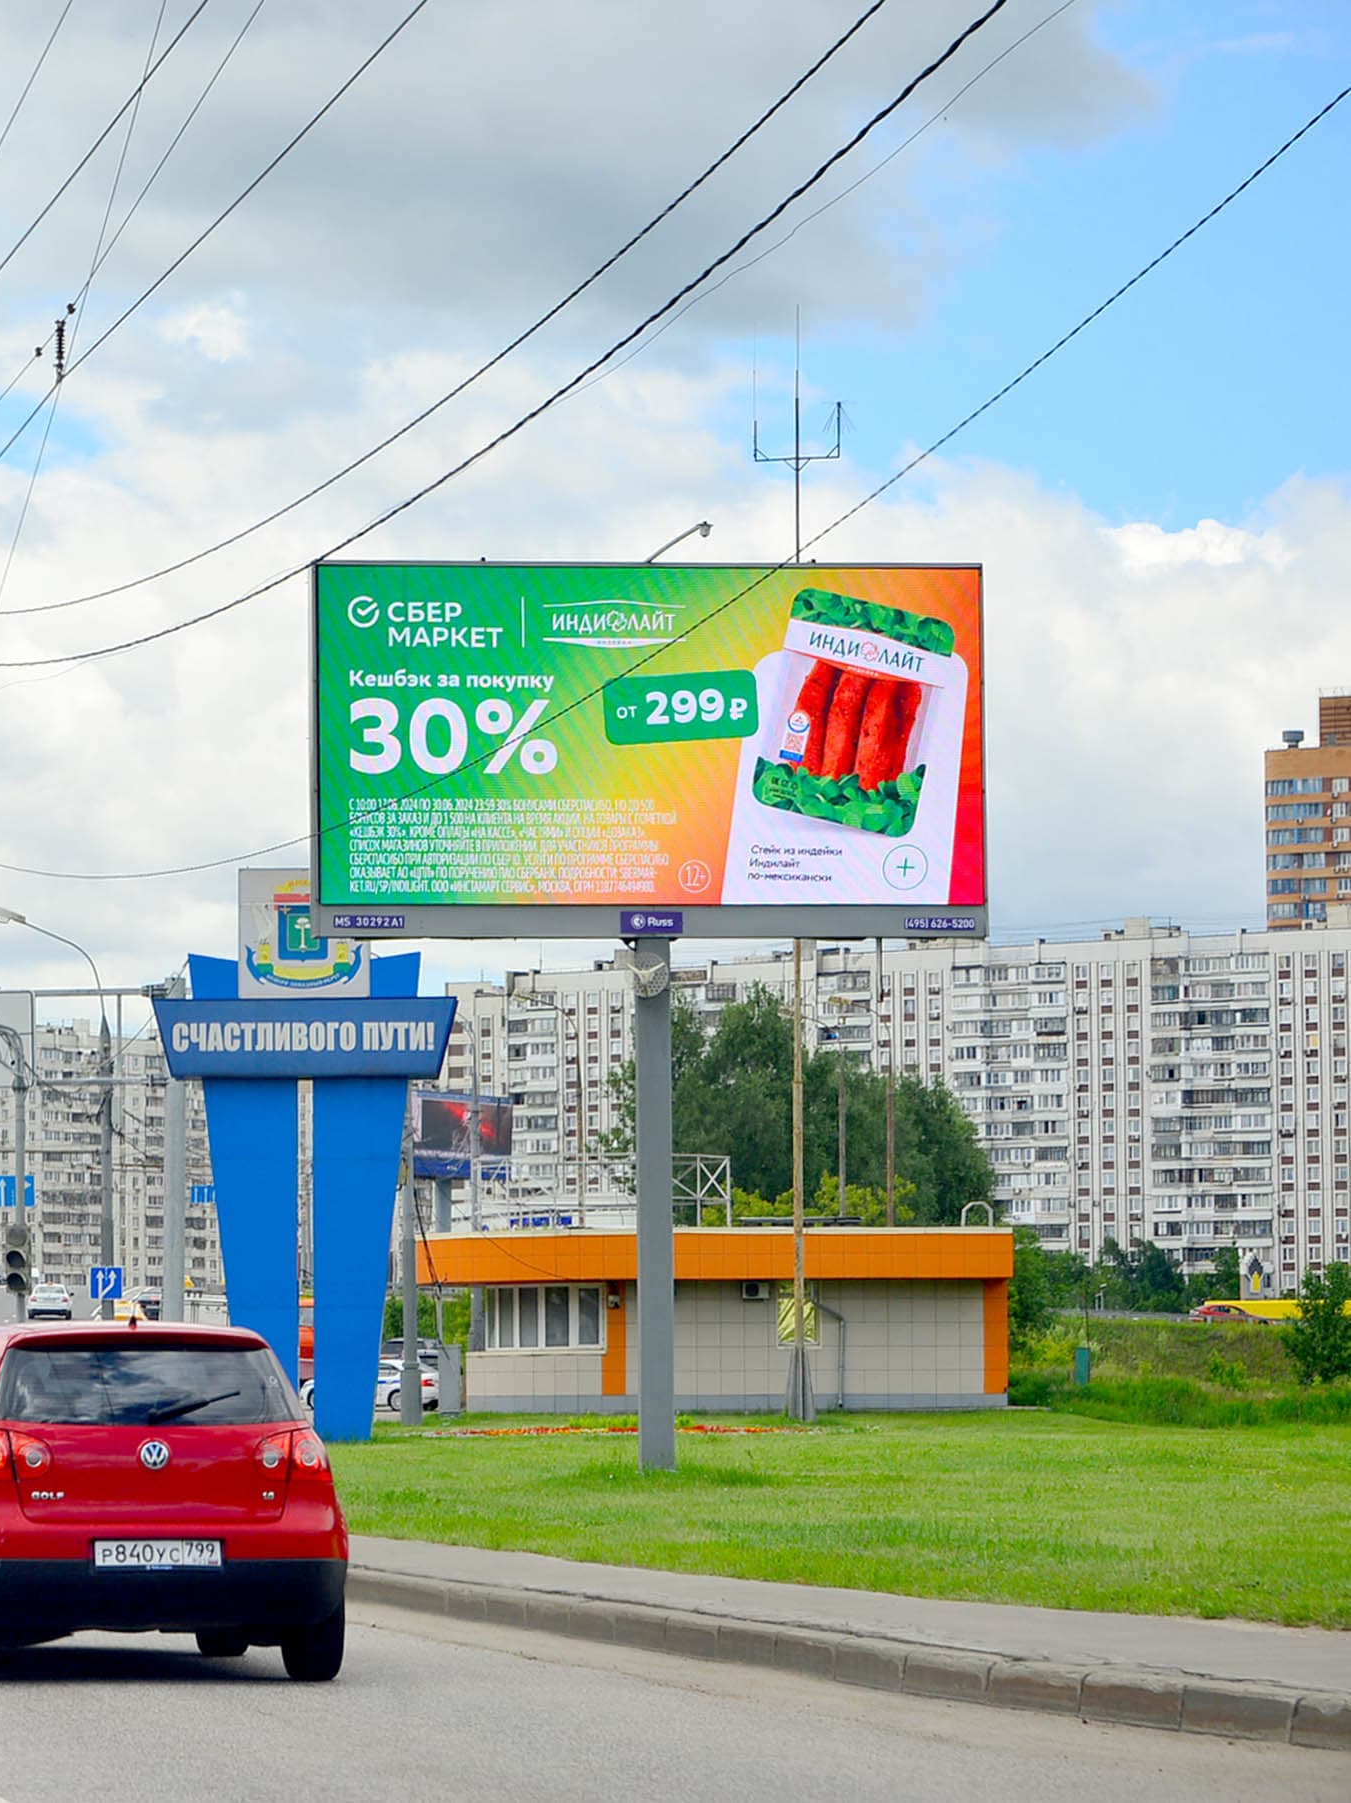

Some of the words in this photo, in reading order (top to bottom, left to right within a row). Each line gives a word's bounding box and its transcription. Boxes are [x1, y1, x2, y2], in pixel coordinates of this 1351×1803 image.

[387, 602, 462, 622] СБЕР
[388, 627, 503, 648] МАРКЕТ
[349, 669, 432, 688] Кешбэк
[437, 674, 460, 688] за
[466, 674, 554, 692] покупку
[616, 705, 638, 719] от
[349, 697, 558, 775] 30%
[751, 844, 781, 855] Стейк
[686, 865, 706, 886] 12+
[334, 916, 351, 927] MS
[647, 916, 674, 927] Russ
[930, 918, 975, 929] 626-5200
[172, 1021, 356, 1052] СЧАСТЛИВОГО
[362, 1021, 435, 1051] ПУТИ!
[31, 1491, 65, 1500] GOLF
